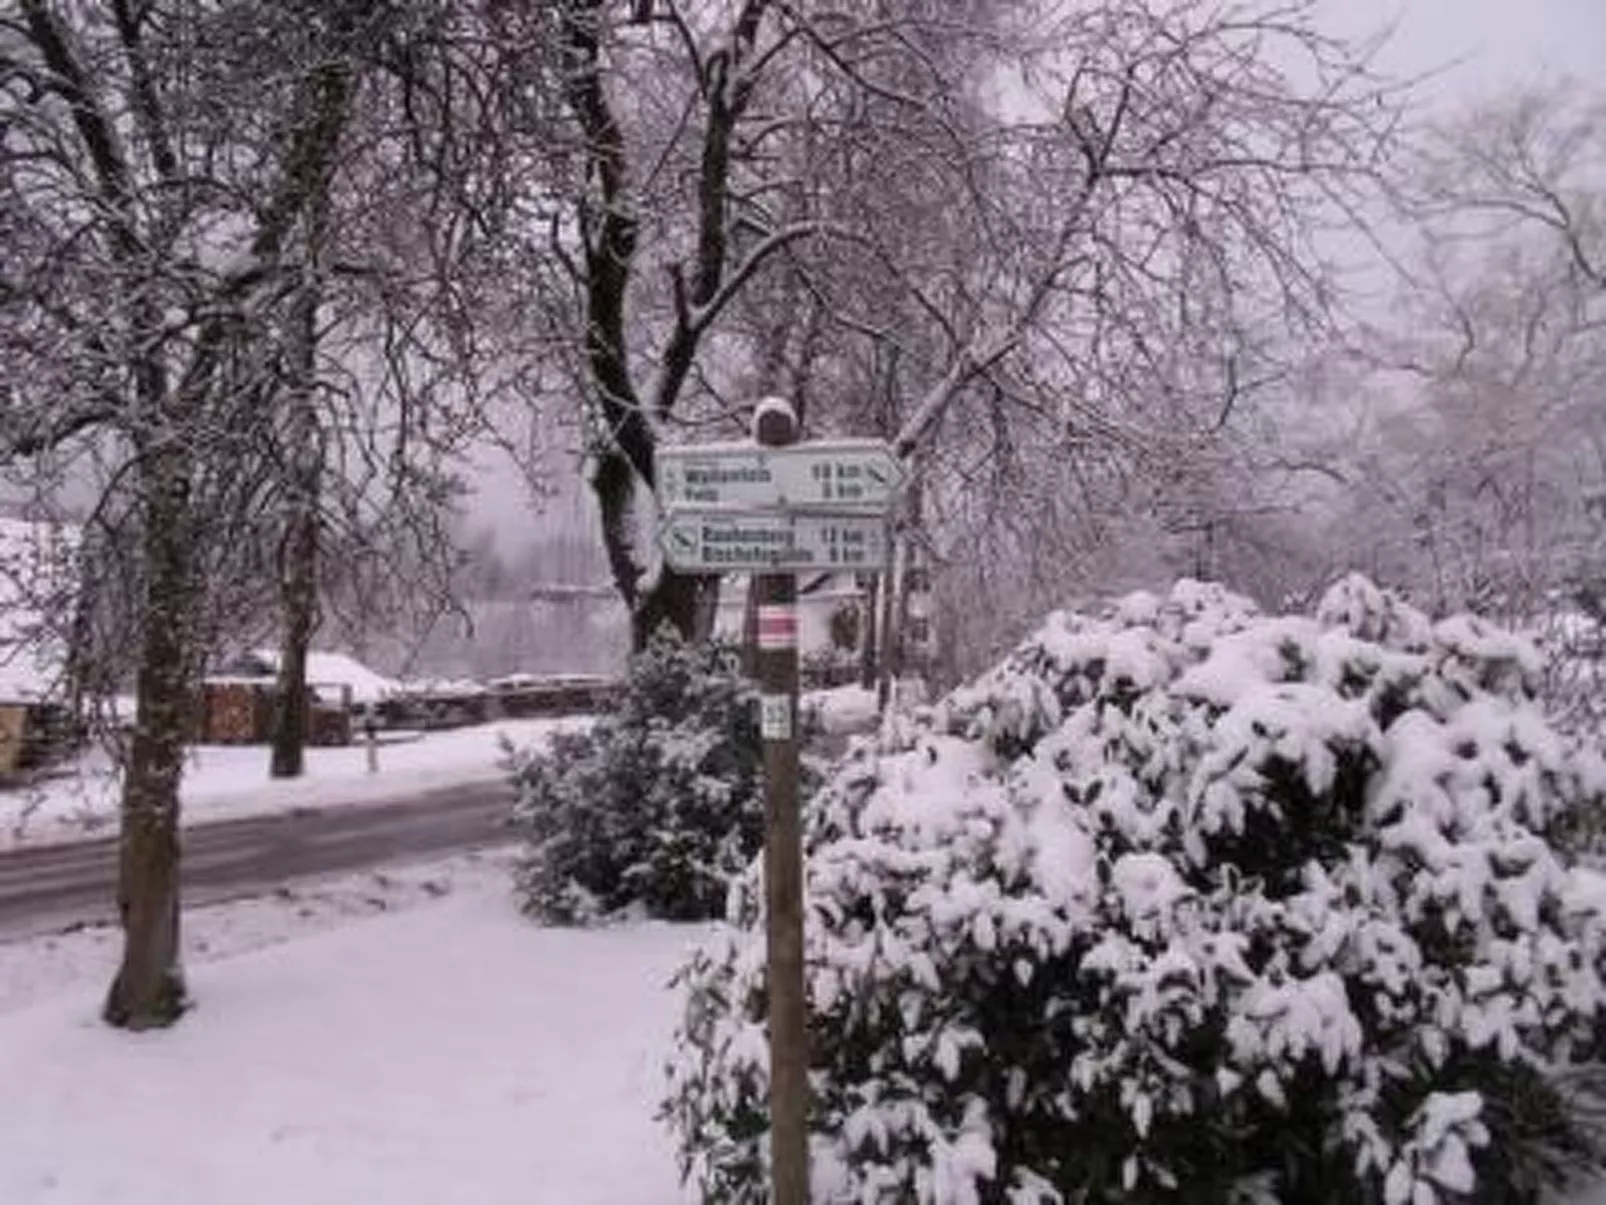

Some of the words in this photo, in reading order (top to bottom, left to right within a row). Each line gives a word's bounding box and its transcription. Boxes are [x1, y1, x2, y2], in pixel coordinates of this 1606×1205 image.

[835, 462, 861, 478] km
[836, 482, 863, 499] km
[842, 527, 865, 543] km
[842, 546, 865, 562] km
